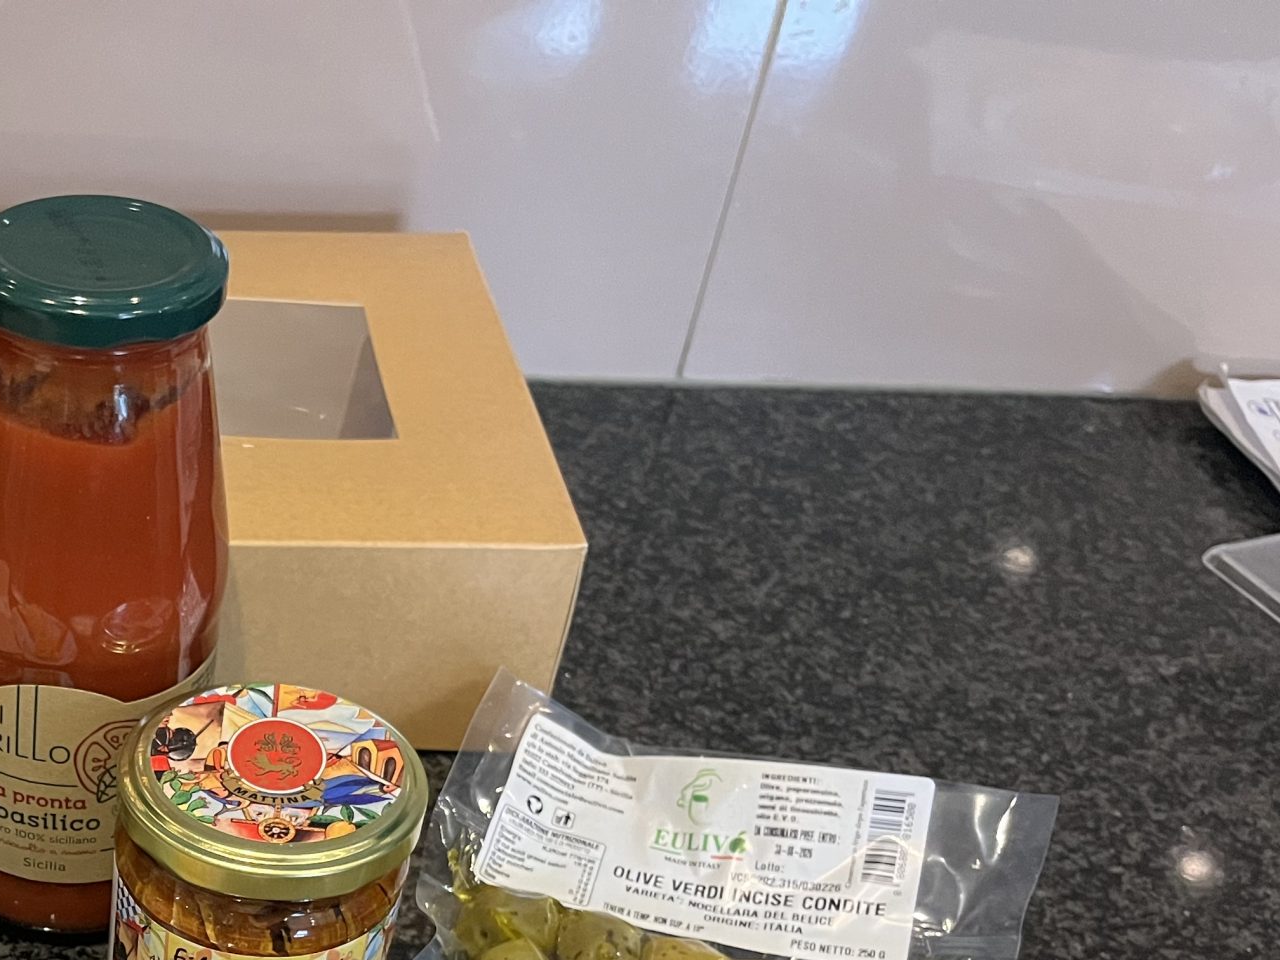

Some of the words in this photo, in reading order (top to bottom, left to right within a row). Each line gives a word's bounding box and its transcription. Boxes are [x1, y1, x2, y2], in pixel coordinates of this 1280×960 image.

[12, 790, 87, 810] pronta
[233, 787, 313, 804] MATTINA
[15, 828, 45, 842] 100%
[49, 835, 97, 845] siciliano
[23, 857, 66, 872] Sicilia
[613, 865, 665, 889] OLIVE
[672, 879, 725, 900] VERDI
[733, 887, 795, 907] INCISE
[802, 896, 888, 917] CONDITE
[688, 900, 758, 917] NOCELLARA
[764, 911, 785, 921] DEL
[791, 913, 834, 926] BELICE
[704, 914, 760, 930] ORIGINE:
[763, 922, 803, 934] ITALIA
[790, 939, 817, 951] PESO
[820, 945, 855, 957] NETTO:
[857, 948, 876, 958] 250
